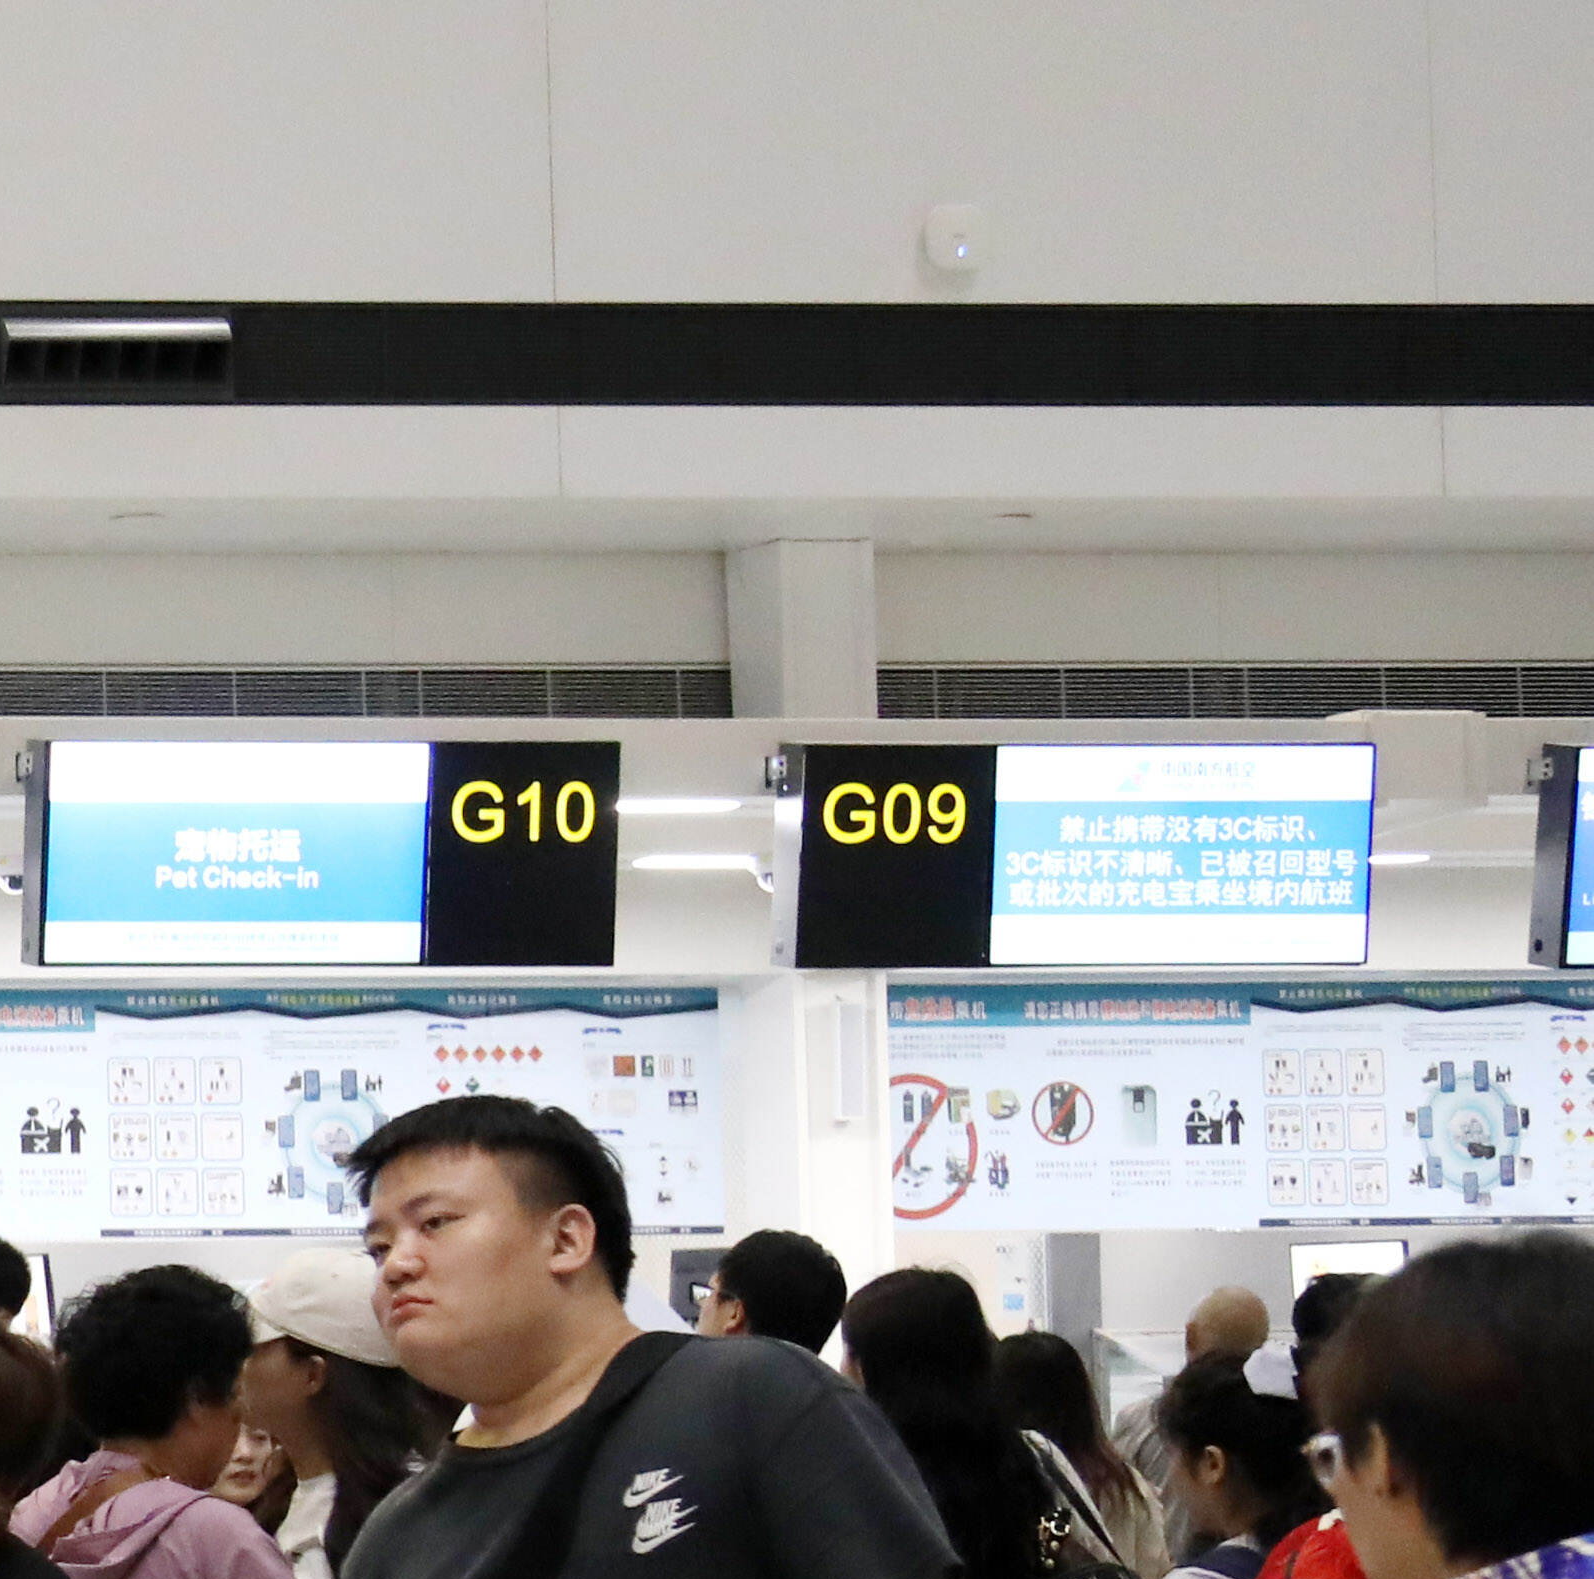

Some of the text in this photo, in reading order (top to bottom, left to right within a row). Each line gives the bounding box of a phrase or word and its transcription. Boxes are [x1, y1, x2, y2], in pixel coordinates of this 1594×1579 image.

[452, 781, 595, 842] G10
[823, 783, 965, 844] G09
[1060, 815, 1318, 843] 禁止携带没有3C标识、
[175, 828, 302, 863] 宠物托运
[155, 866, 319, 889] Pet Check-in
[1006, 849, 1358, 878] 3C标识不清晰、已被召回型号
[1009, 881, 1353, 907] 或批次的充电宝乘坐境内航班
[632, 1467, 670, 1493] NIKE
